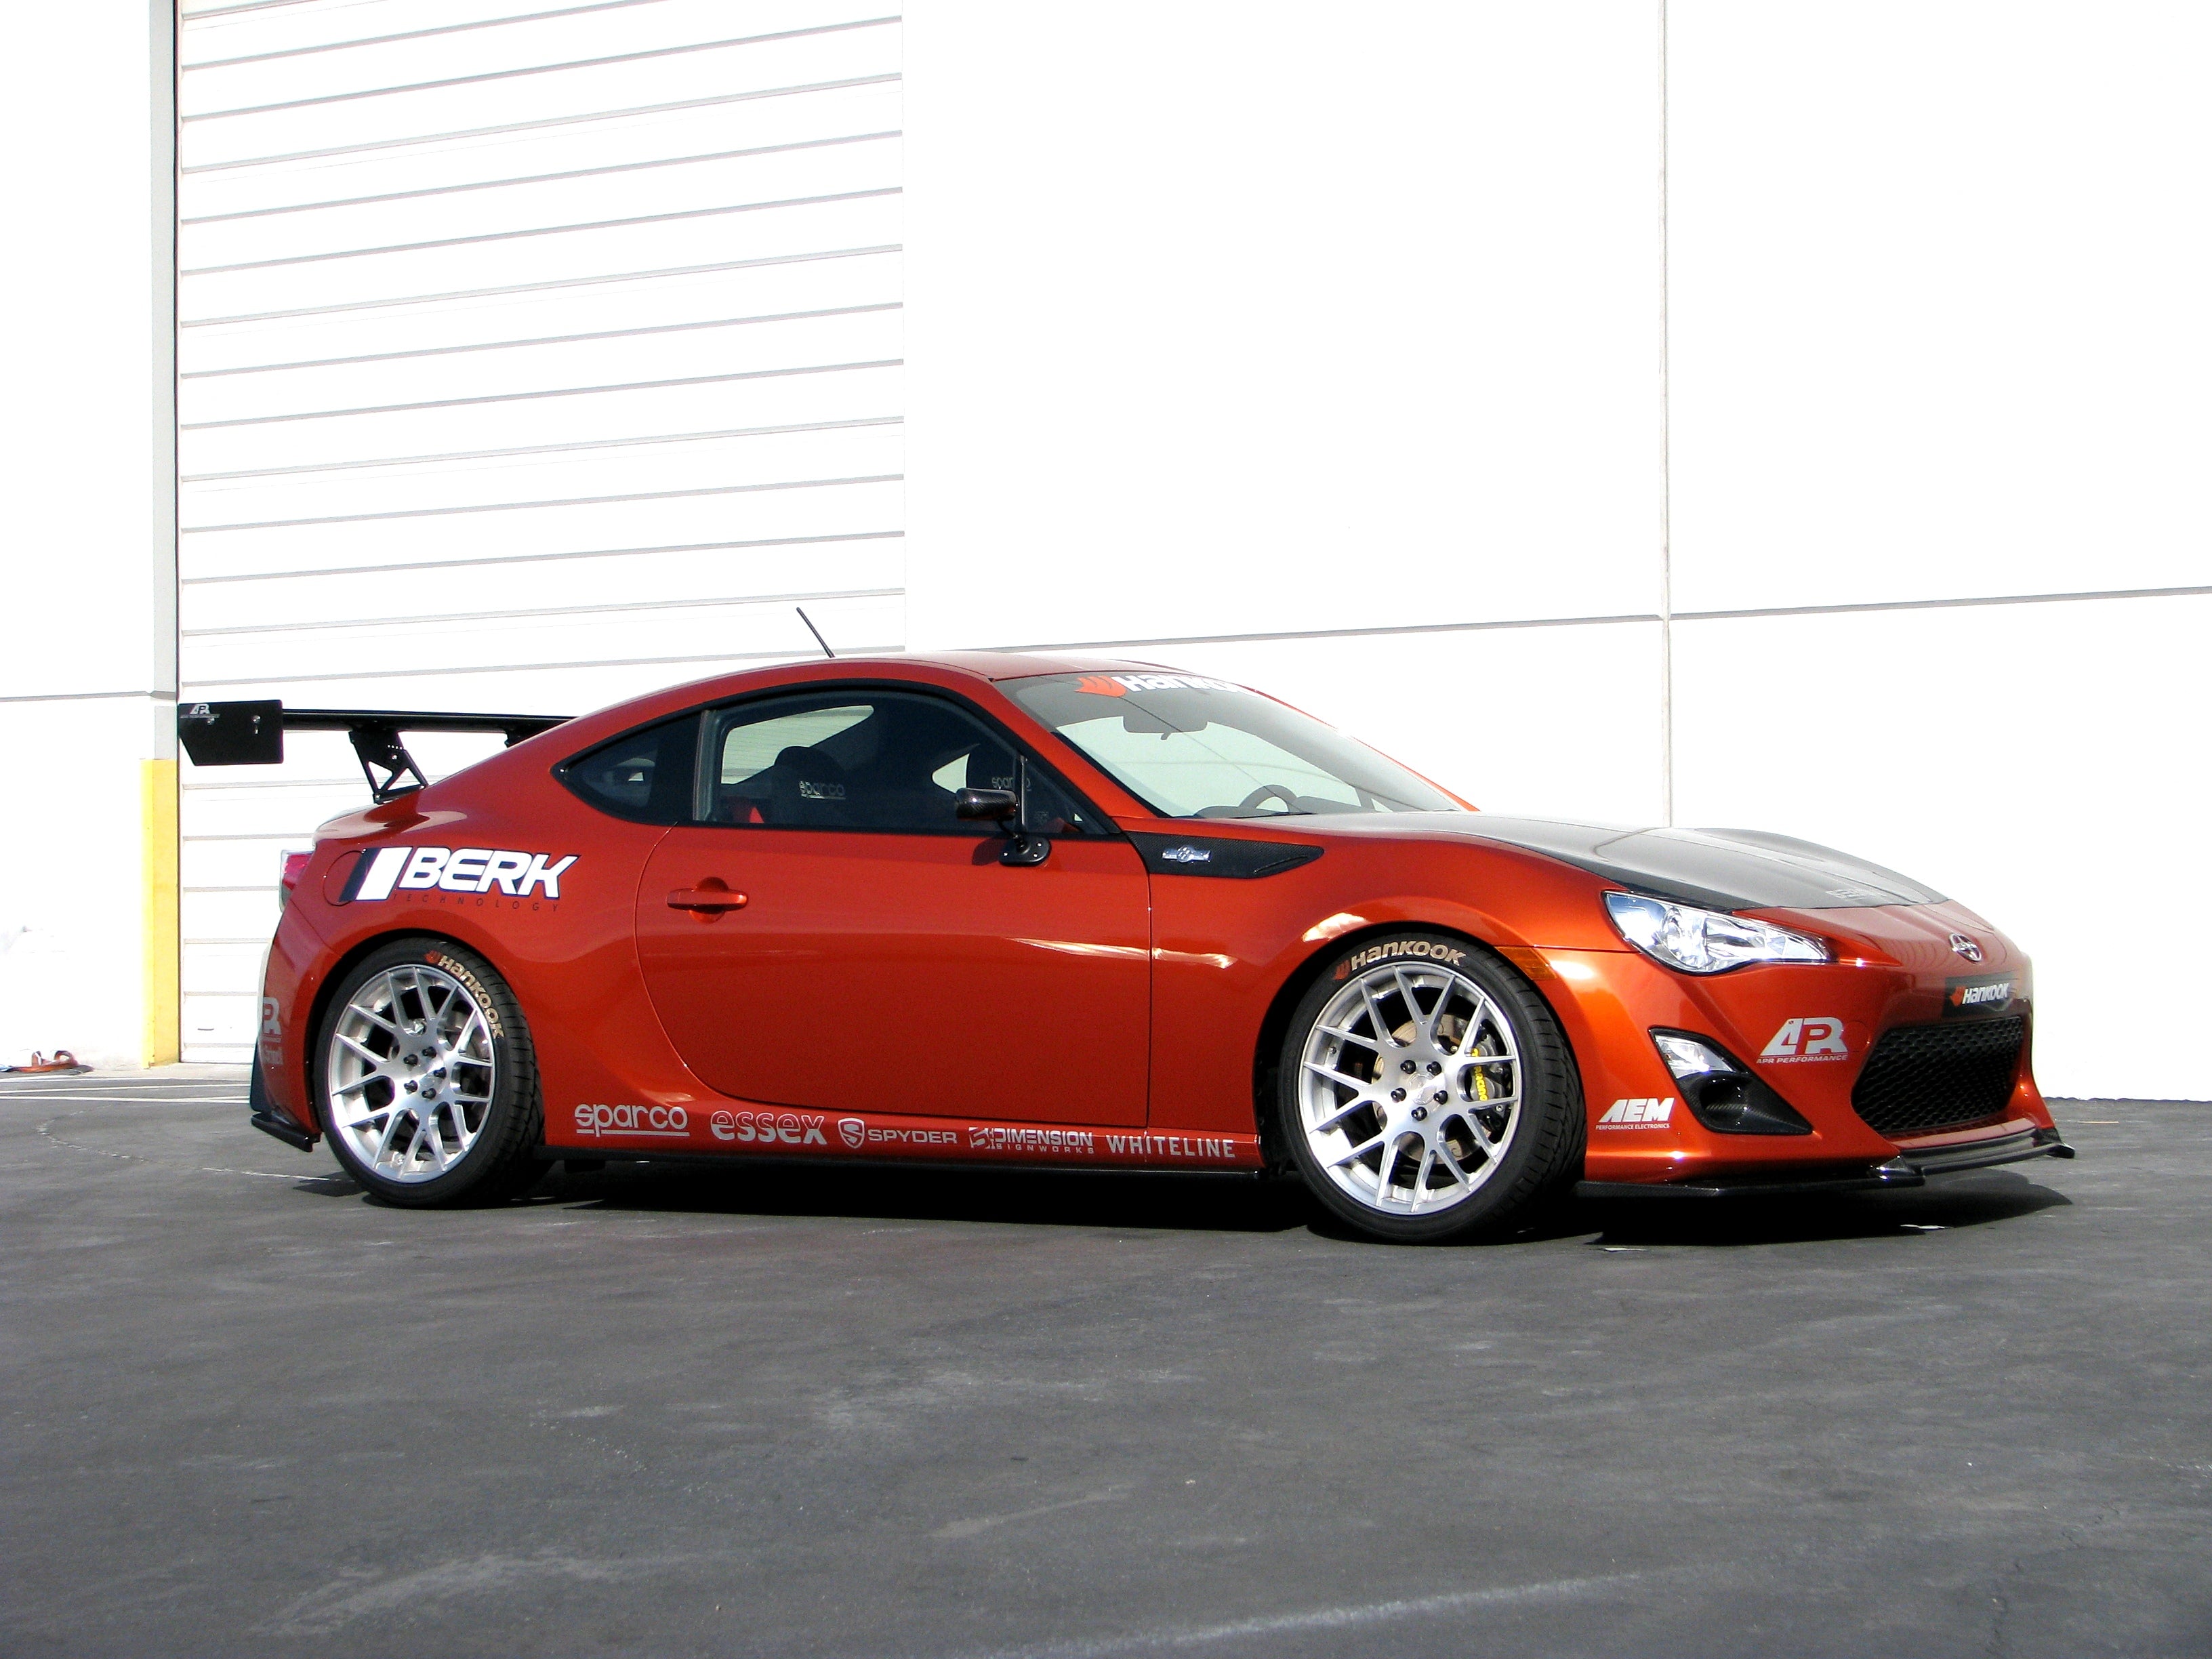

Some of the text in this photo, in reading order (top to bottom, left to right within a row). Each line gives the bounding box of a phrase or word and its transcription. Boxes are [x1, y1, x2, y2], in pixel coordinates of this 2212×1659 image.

[398, 846, 581, 899] BERK
[392, 894, 558, 912] TECHNOLOGY
[1759, 1017, 1848, 1056] APR
[1776, 1054, 1848, 1063] PERFORMANCE
[574, 1103, 689, 1137] sparco
[1598, 1097, 1675, 1123] AEM
[710, 1109, 828, 1145] essex
[867, 1129, 958, 1144] SPYDER
[994, 1128, 1094, 1147] DIMENSION
[1106, 1134, 1235, 1158] WHITELINE
